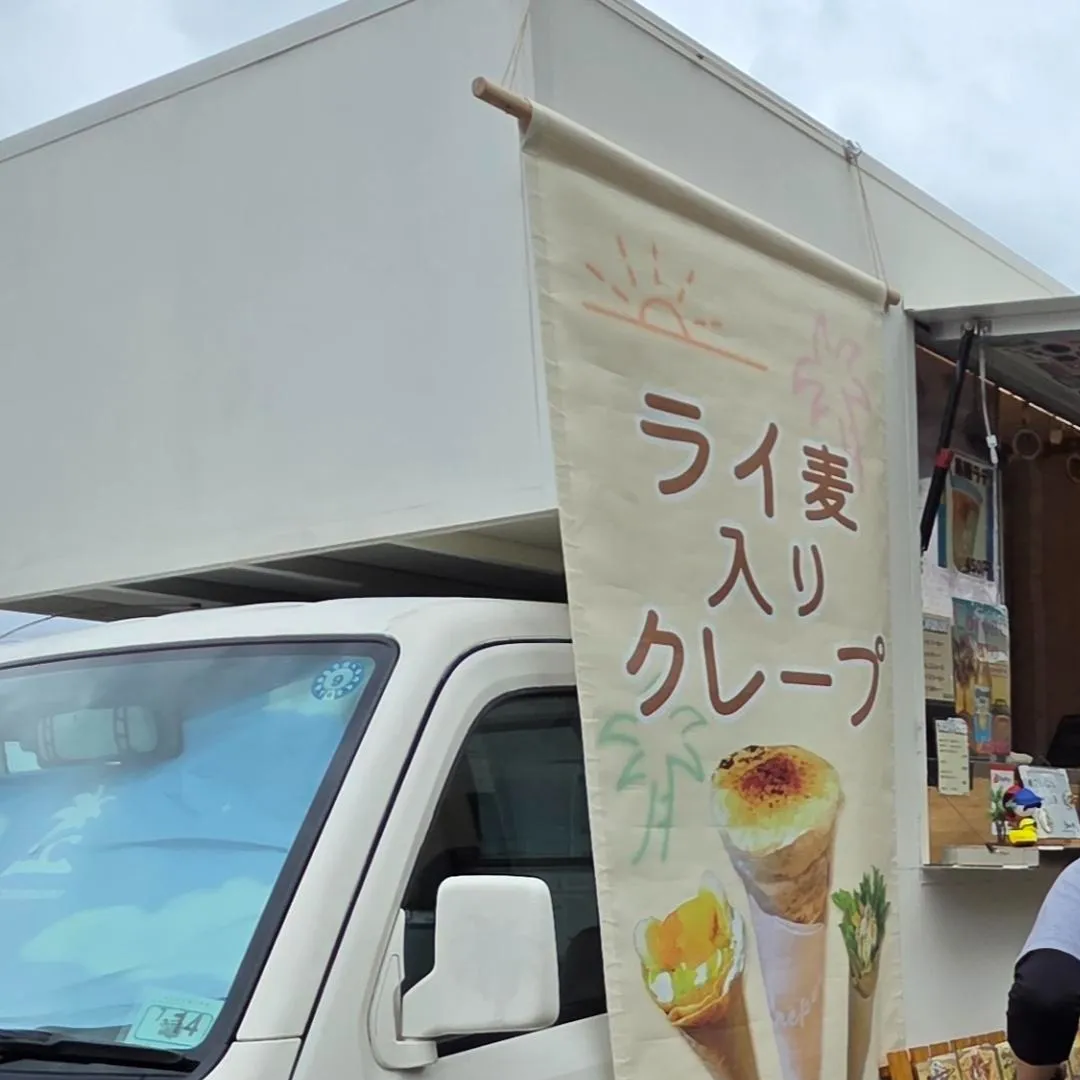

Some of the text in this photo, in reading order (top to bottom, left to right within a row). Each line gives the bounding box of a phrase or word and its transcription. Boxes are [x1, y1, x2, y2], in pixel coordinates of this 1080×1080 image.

[641, 391, 858, 532] ライ麦
[708, 526, 825, 616] 入り
[626, 609, 886, 727] クレープ
